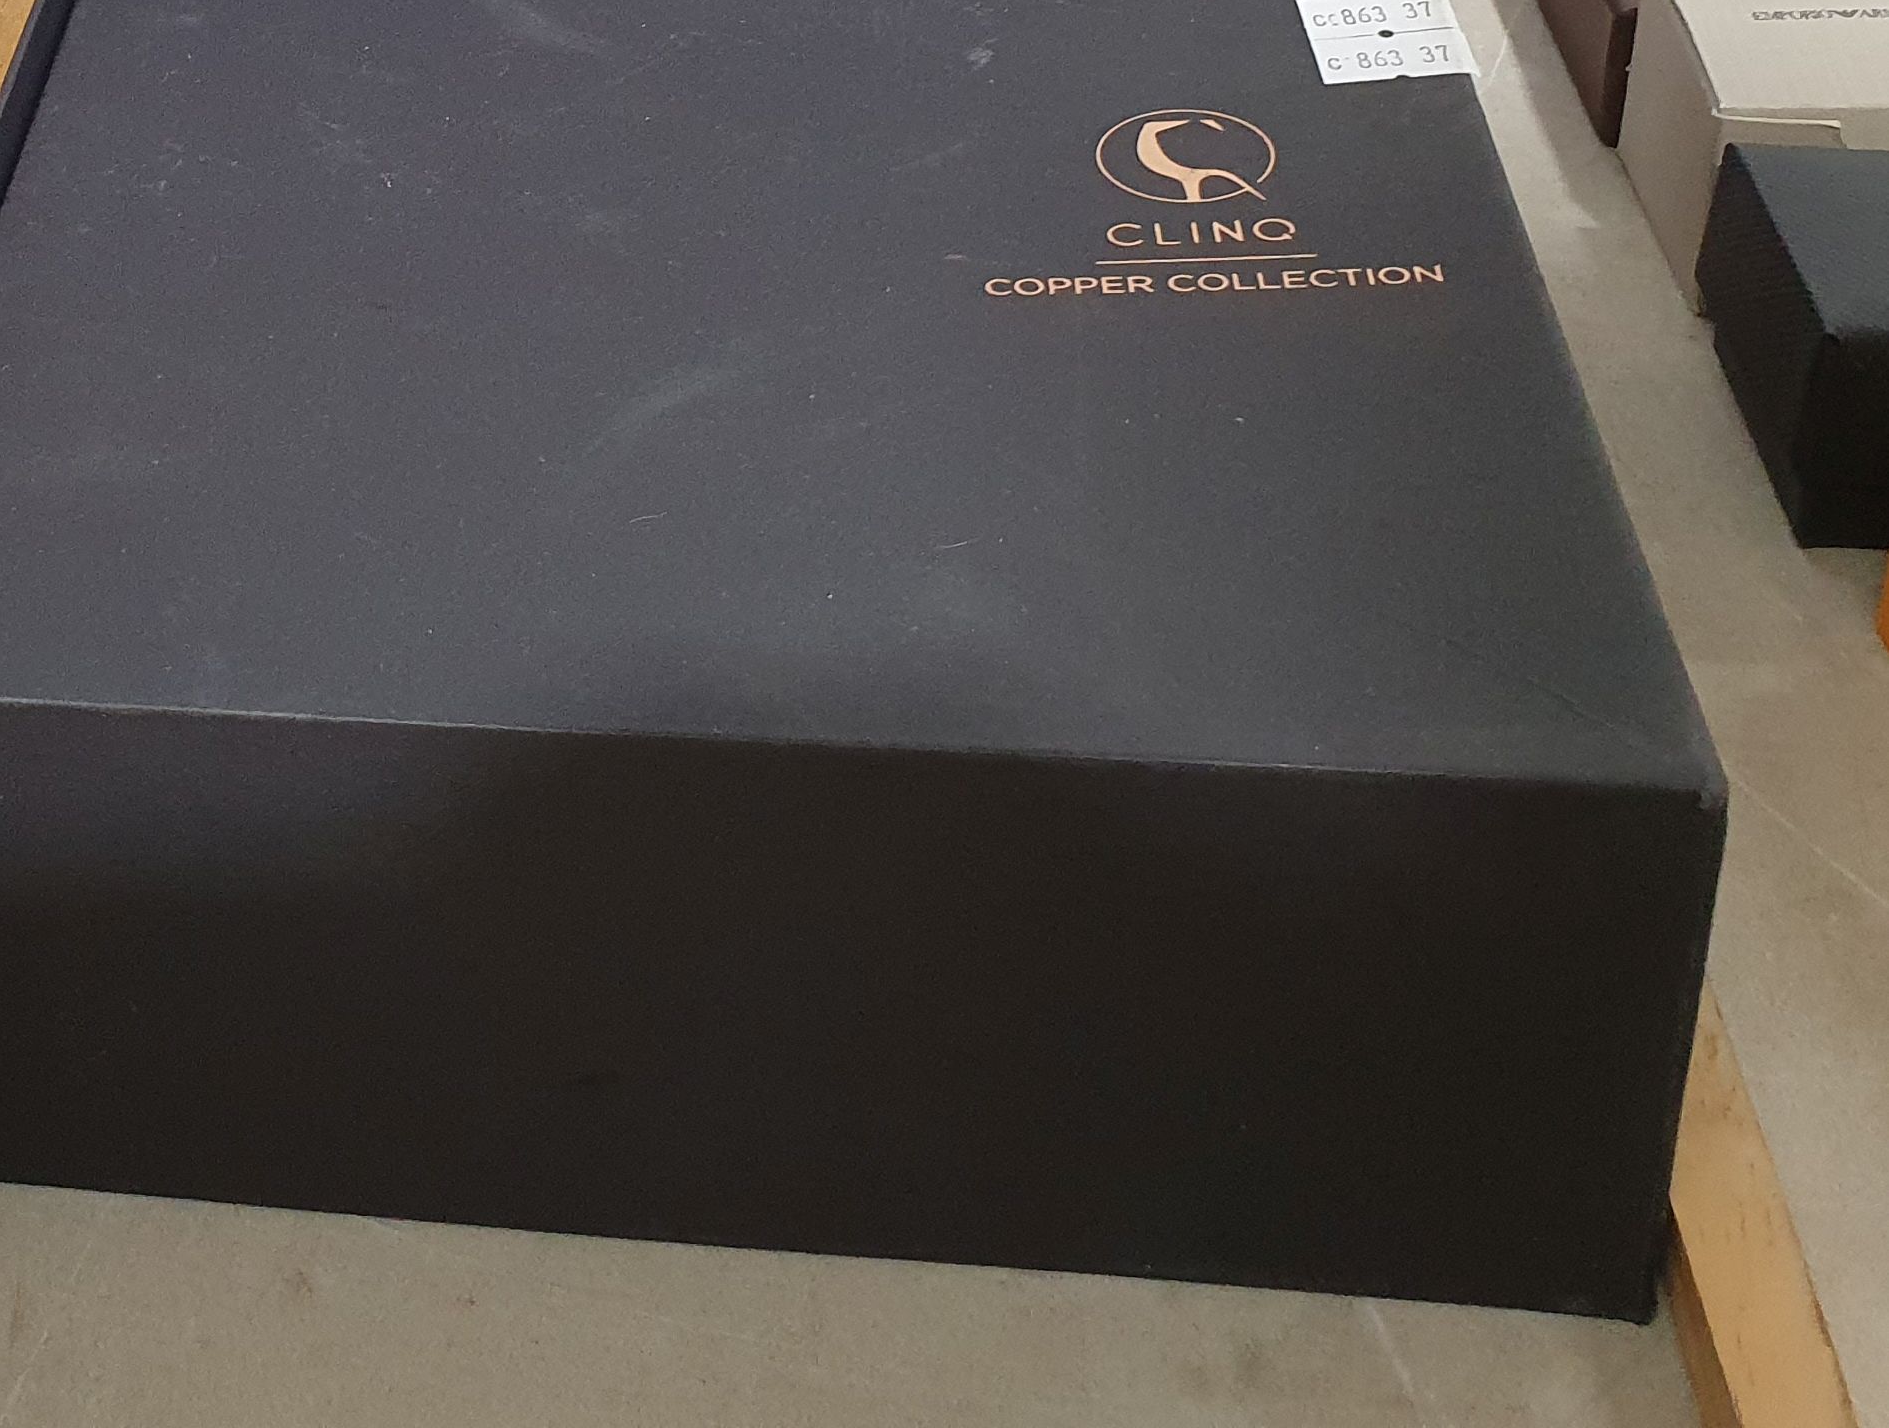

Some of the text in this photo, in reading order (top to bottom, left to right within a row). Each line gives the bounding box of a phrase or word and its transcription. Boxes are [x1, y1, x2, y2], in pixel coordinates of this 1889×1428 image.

[1402, 0, 1432, 19] 37
[1419, 44, 1450, 63] 37
[1105, 217, 1296, 247] CLINQ
[984, 263, 1445, 297] COPPER COLLECTION
